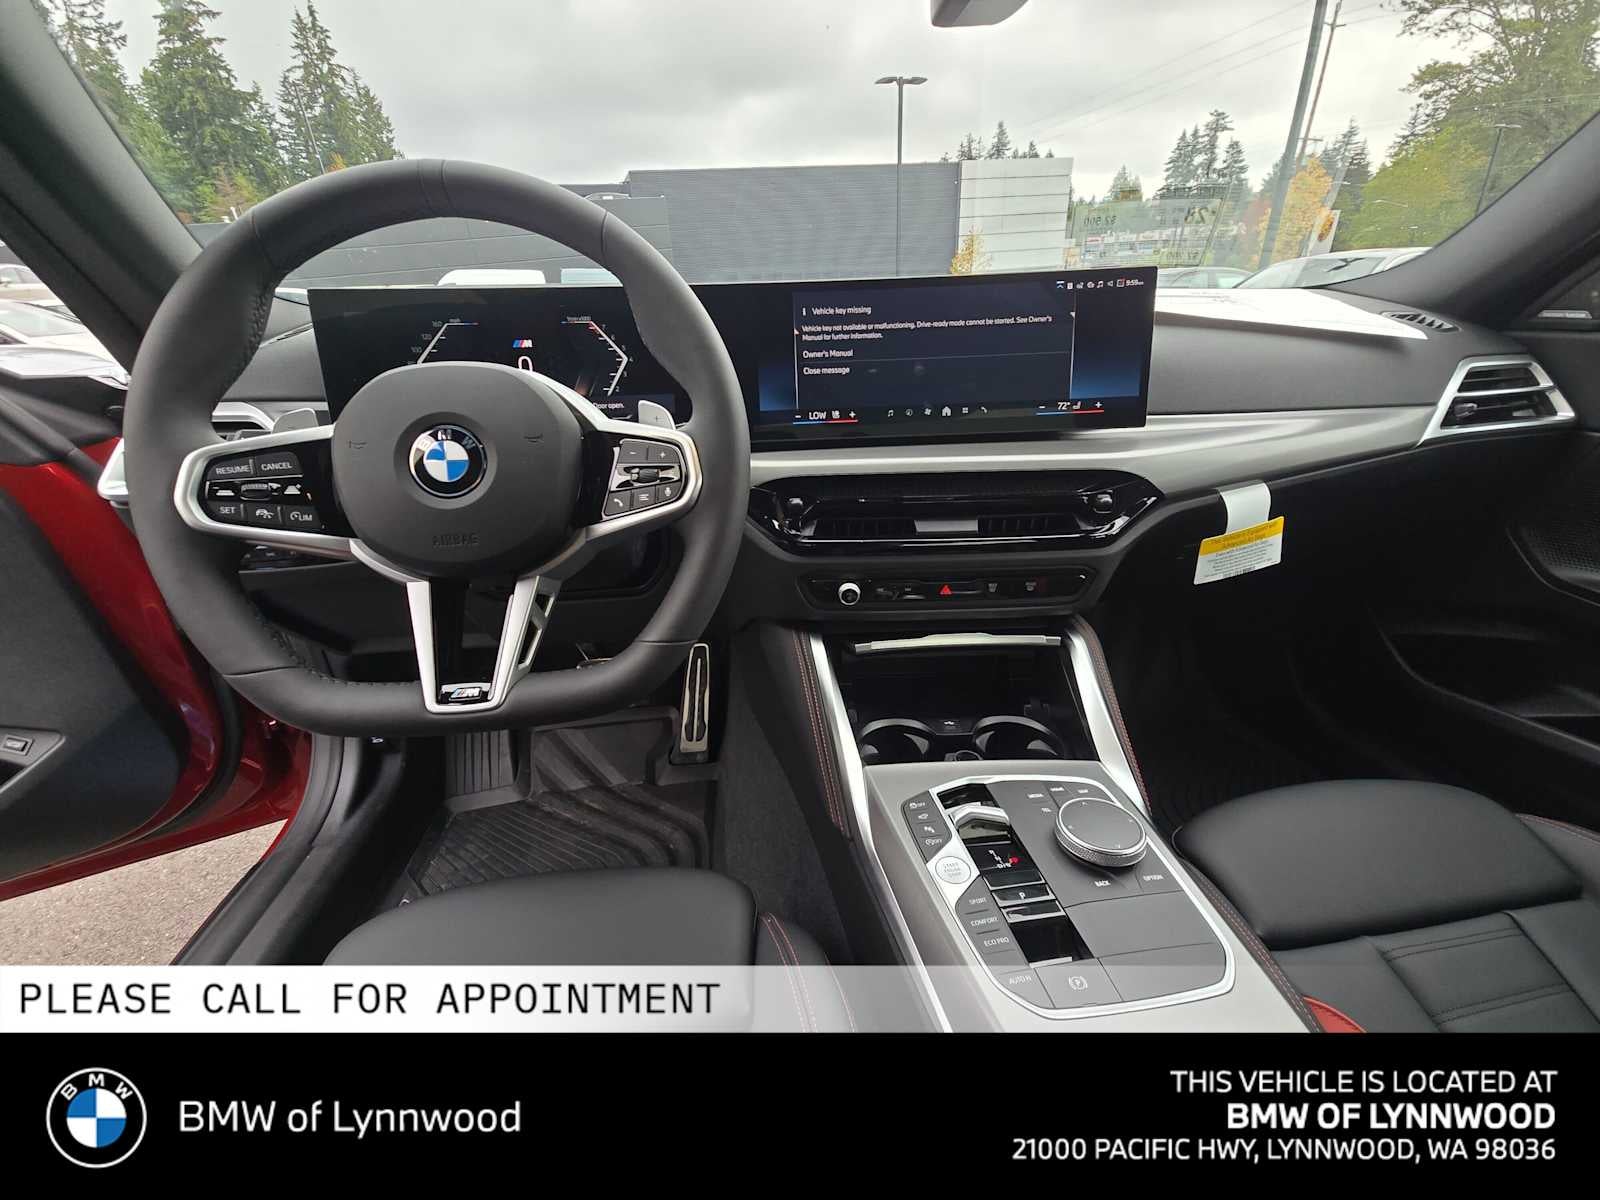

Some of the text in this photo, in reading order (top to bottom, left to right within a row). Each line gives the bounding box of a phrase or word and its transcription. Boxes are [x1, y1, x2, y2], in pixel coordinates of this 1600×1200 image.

[812, 305, 872, 316] Vehicle key missing
[843, 322, 867, 331] available
[917, 320, 949, 328] Drive-ready
[966, 318, 985, 326] cannot
[986, 317, 993, 325] be
[1028, 315, 1053, 323] Owner's
[803, 349, 853, 359] Owner's Manual
[803, 367, 850, 376] Close message
[809, 411, 826, 420] LOW
[215, 464, 250, 475] RESUME
[261, 461, 292, 471] CANCEL
[220, 506, 236, 514] SET
[970, 915, 999, 927] COMFORT
